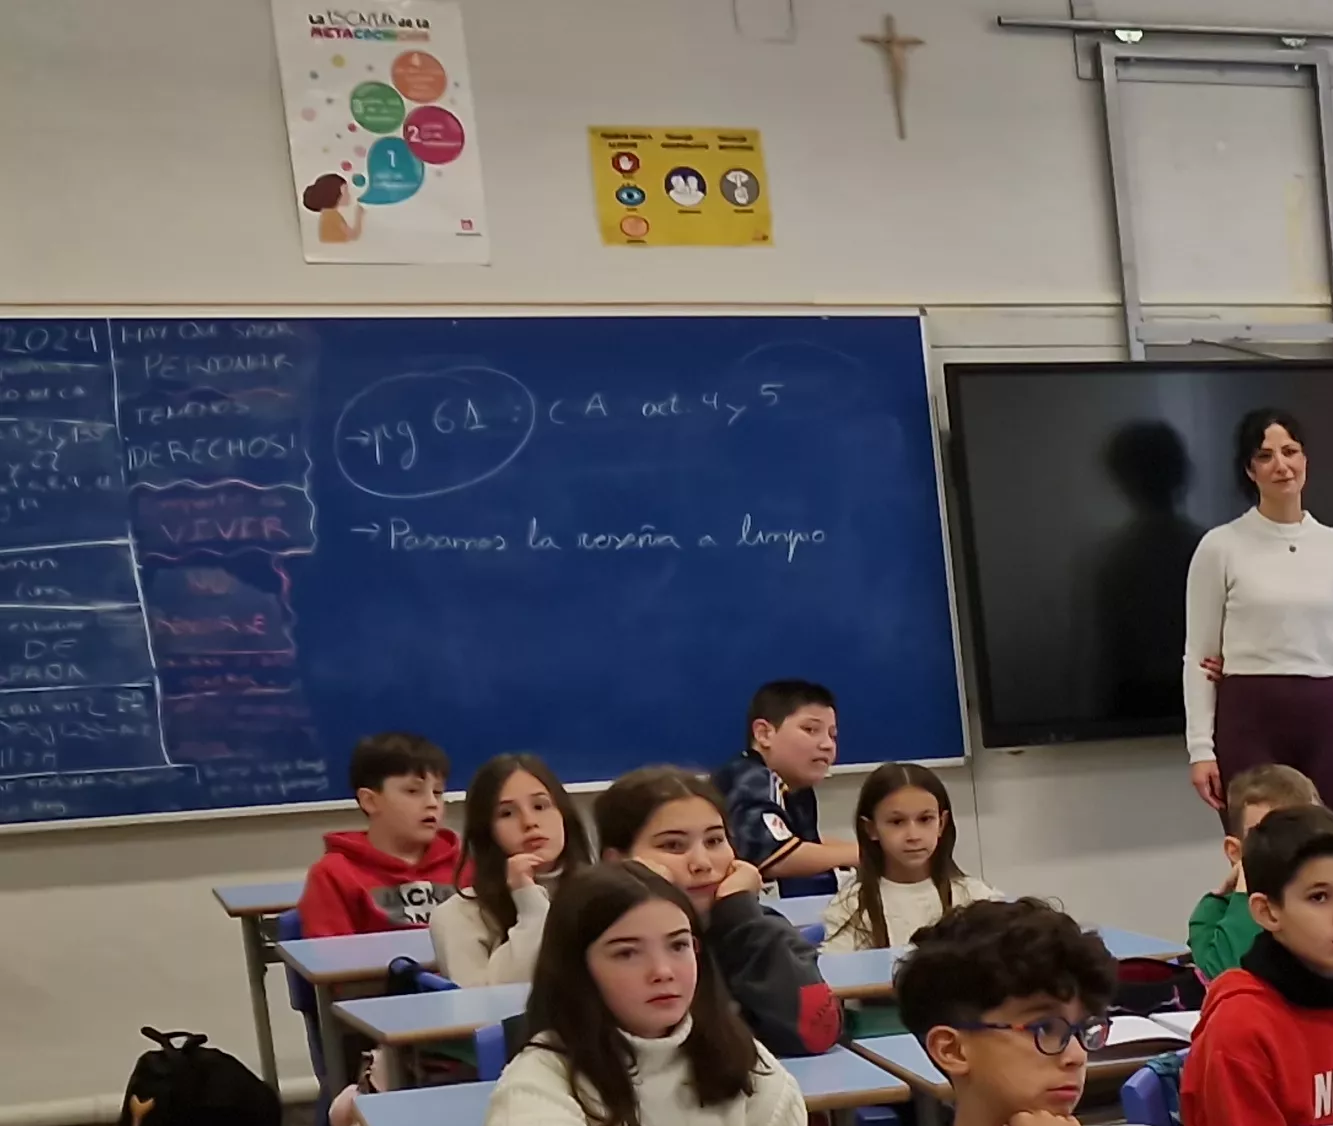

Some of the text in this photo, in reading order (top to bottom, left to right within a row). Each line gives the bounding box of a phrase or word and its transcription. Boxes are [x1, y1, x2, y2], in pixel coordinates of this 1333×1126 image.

[760, 383, 785, 406] 5
[389, 518, 506, 551] Pasamos
[528, 516, 562, 550] la
[699, 533, 718, 548] a
